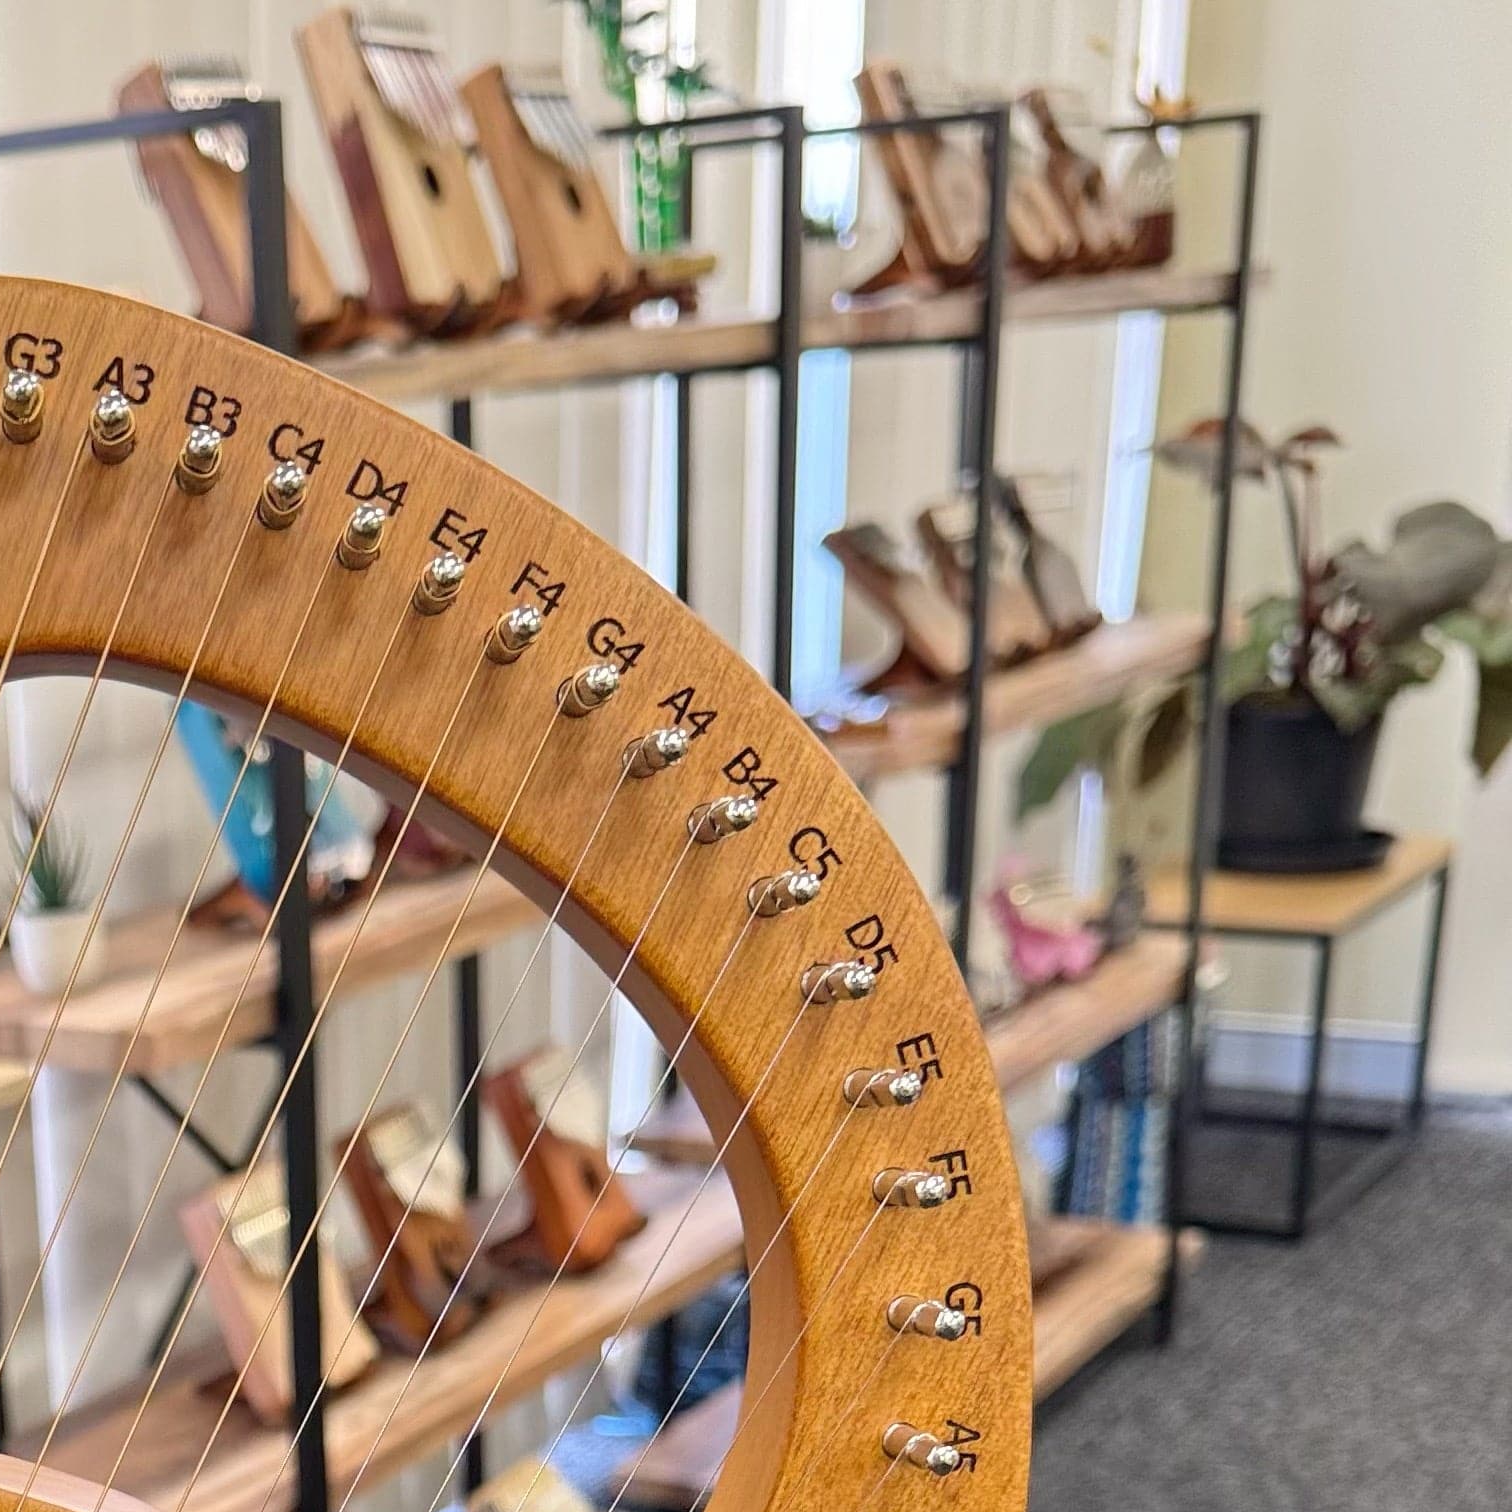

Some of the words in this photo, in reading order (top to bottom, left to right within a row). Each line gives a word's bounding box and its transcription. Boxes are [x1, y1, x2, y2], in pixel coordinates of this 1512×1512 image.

[3, 332, 63, 379] G3
[93, 356, 156, 405] A3
[185, 385, 242, 438] B3
[268, 423, 325, 475] C4
[345, 458, 408, 515] D4
[428, 508, 488, 562] E4
[510, 562, 566, 615] F4
[586, 617, 645, 674] G4
[658, 687, 718, 740] A4
[722, 746, 778, 801] B4
[789, 827, 843, 882] C5
[844, 914, 899, 974] D5
[928, 1149, 972, 1198] F5
